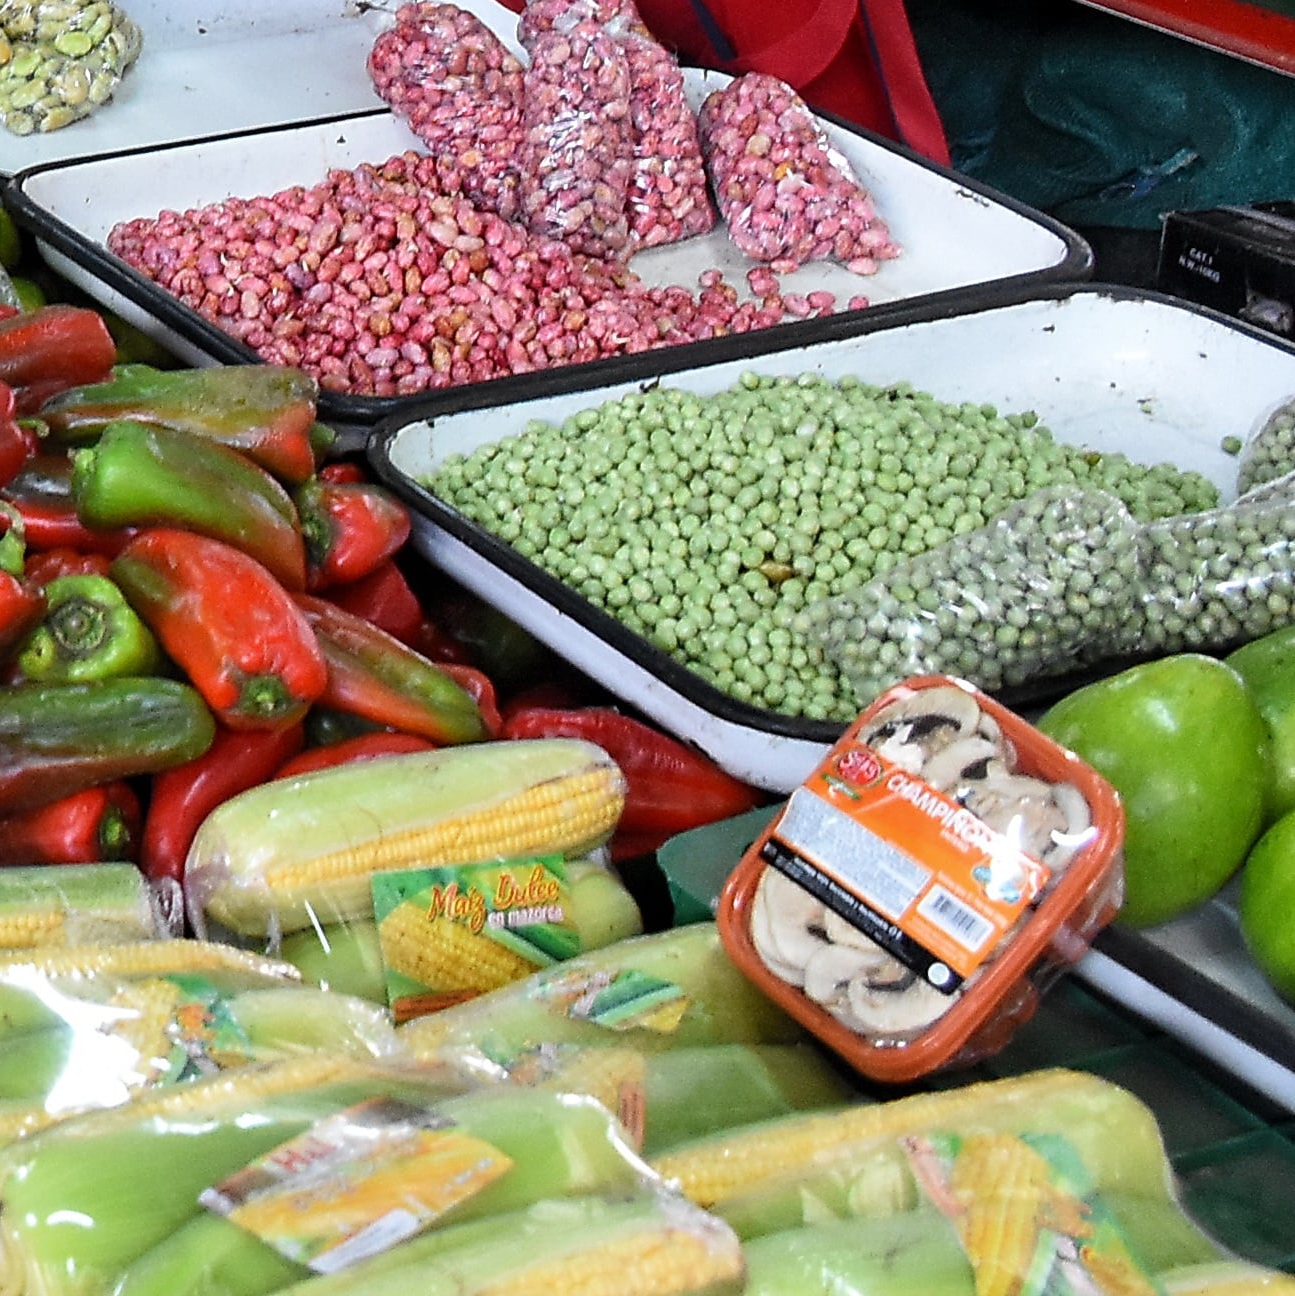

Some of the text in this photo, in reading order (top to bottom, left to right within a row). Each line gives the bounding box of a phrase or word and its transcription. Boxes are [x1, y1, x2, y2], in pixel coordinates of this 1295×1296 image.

[493, 864, 560, 909] Dulce
[487, 905, 565, 930] en mazorca
